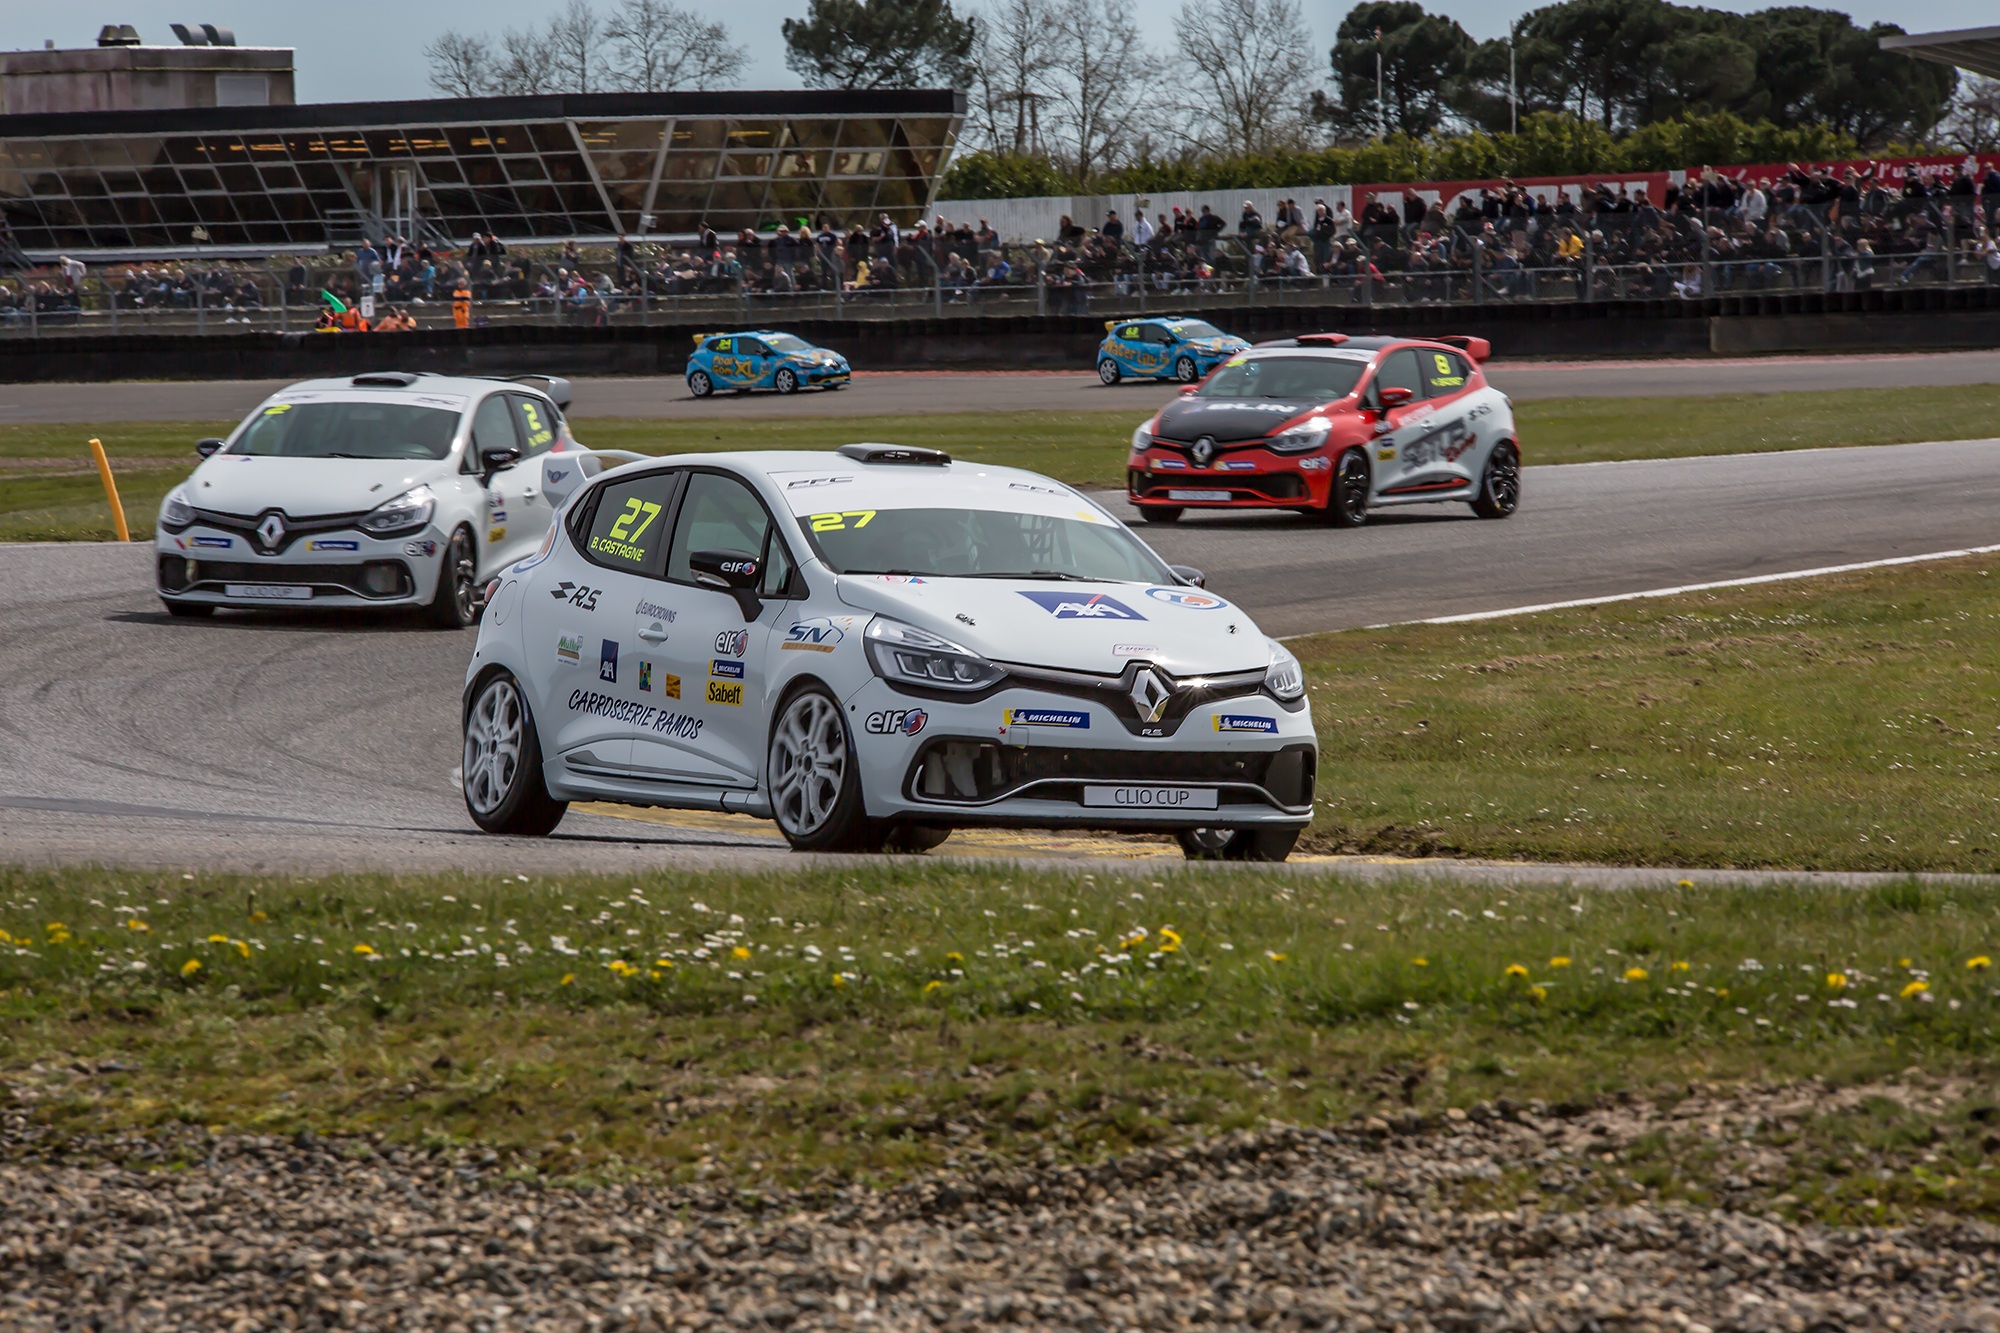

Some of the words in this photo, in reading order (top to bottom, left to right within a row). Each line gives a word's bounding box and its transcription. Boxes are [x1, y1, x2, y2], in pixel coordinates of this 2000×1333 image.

[734, 358, 757, 378] XL
[1434, 354, 1451, 375] 8
[522, 403, 542, 431] 2
[609, 497, 662, 543] 27
[810, 510, 876, 532] 27
[720, 561, 743, 573] elf
[1051, 602, 1131, 618] AXA
[715, 631, 736, 654] elf
[784, 624, 833, 643] SN
[708, 681, 741, 705] Sabelt
[568, 689, 657, 727] CARROSSERIE
[652, 709, 703, 739] RAMOS
[866, 711, 902, 733] elf
[1028, 714, 1081, 724] MICHELIN
[1232, 719, 1272, 729] MICHELIN
[1114, 788, 1152, 805] CLIO
[1156, 789, 1190, 806] CUP
